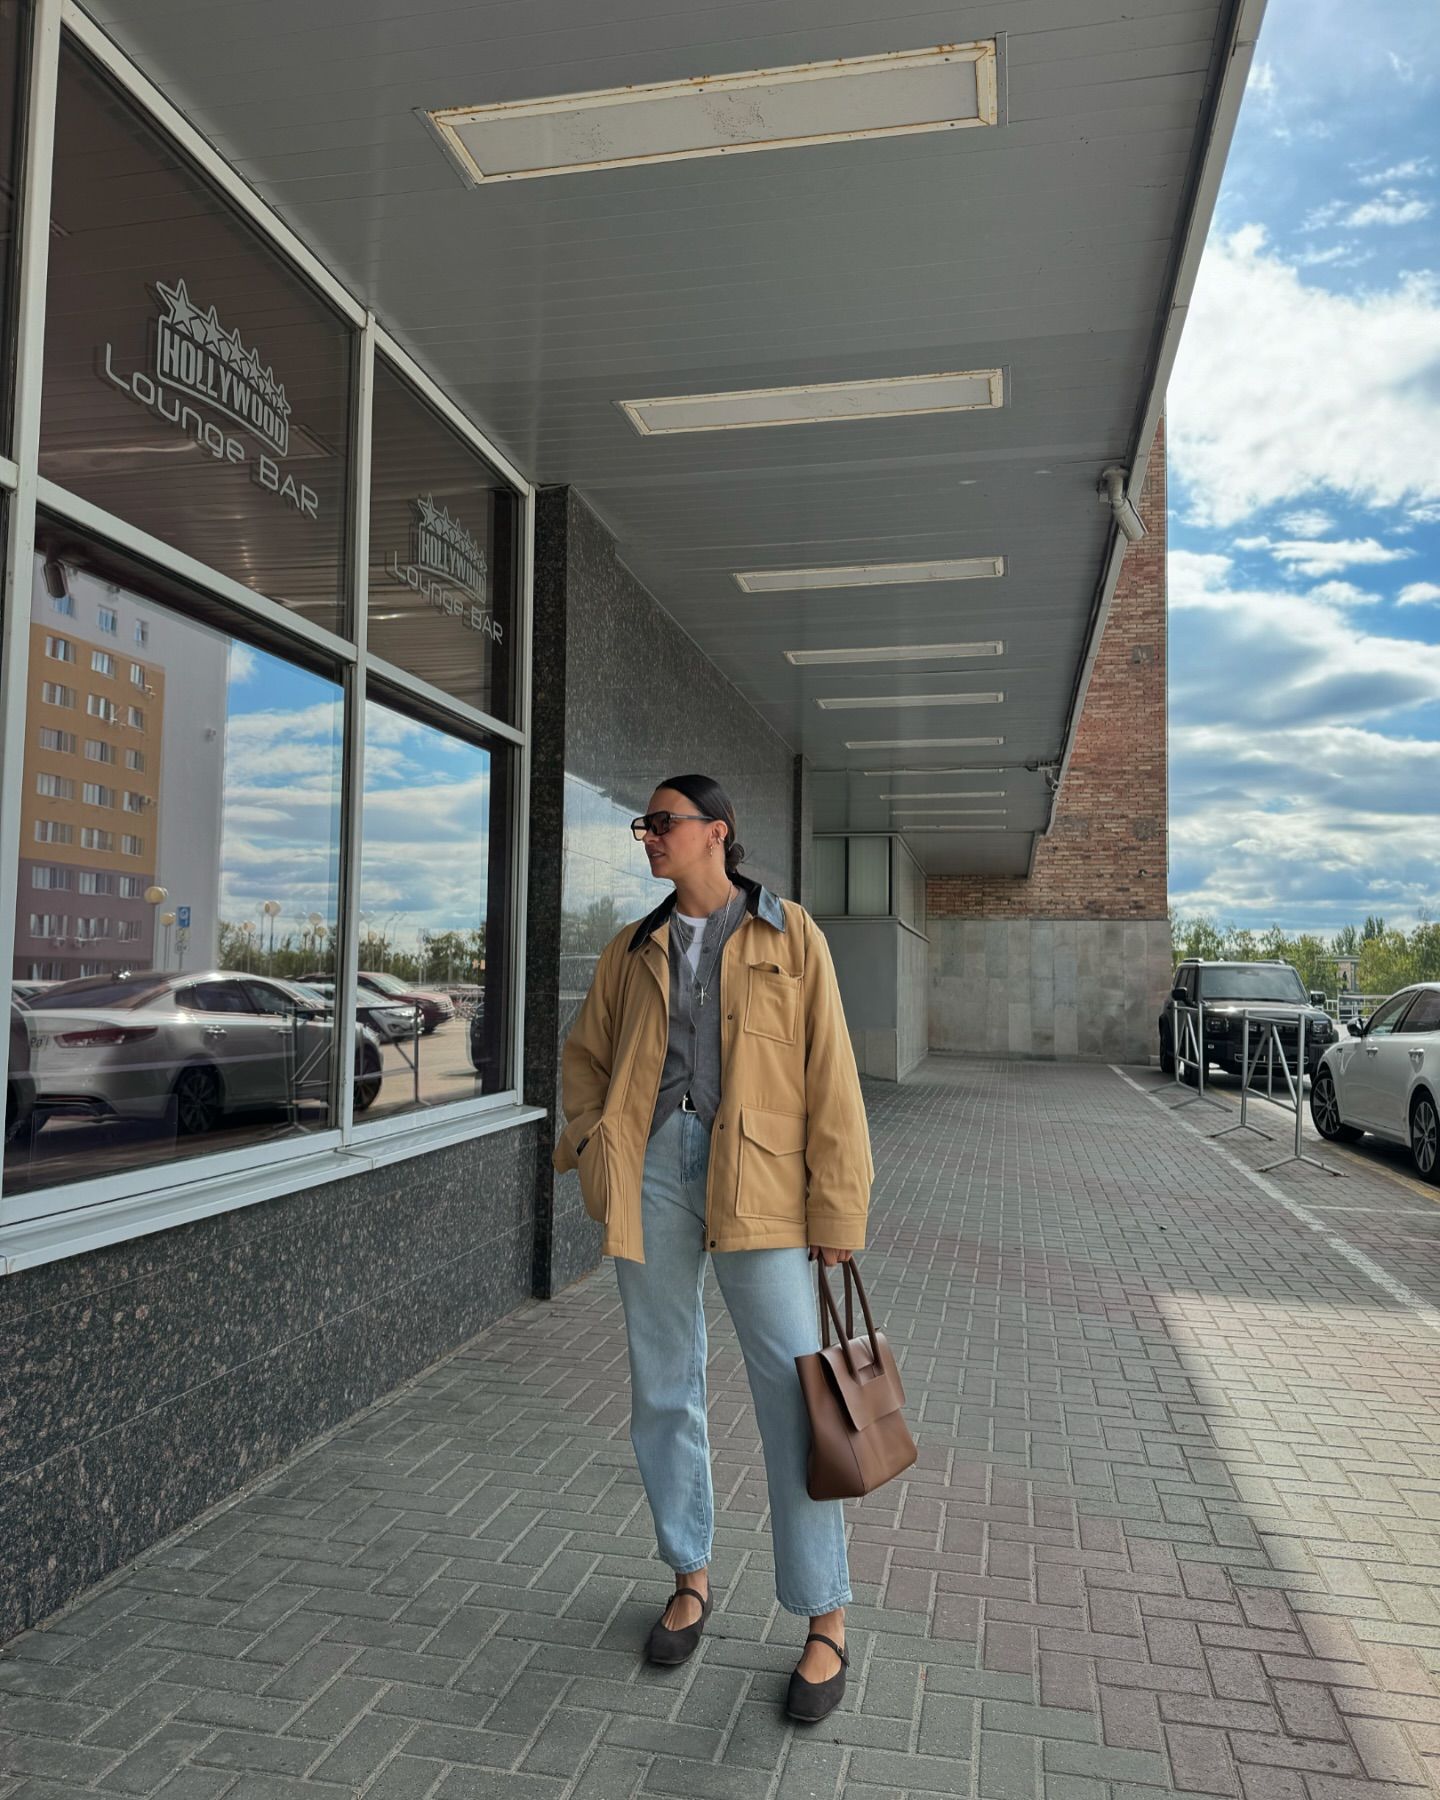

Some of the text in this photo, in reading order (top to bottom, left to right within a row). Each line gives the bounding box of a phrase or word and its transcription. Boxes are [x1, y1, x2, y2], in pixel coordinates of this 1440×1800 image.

[105, 342, 319, 520] Lounge BAR
[162, 326, 287, 448] HOLLYWOOD
[394, 550, 503, 645] Lounge BAR
[420, 529, 486, 601] HOLLYWOOD
